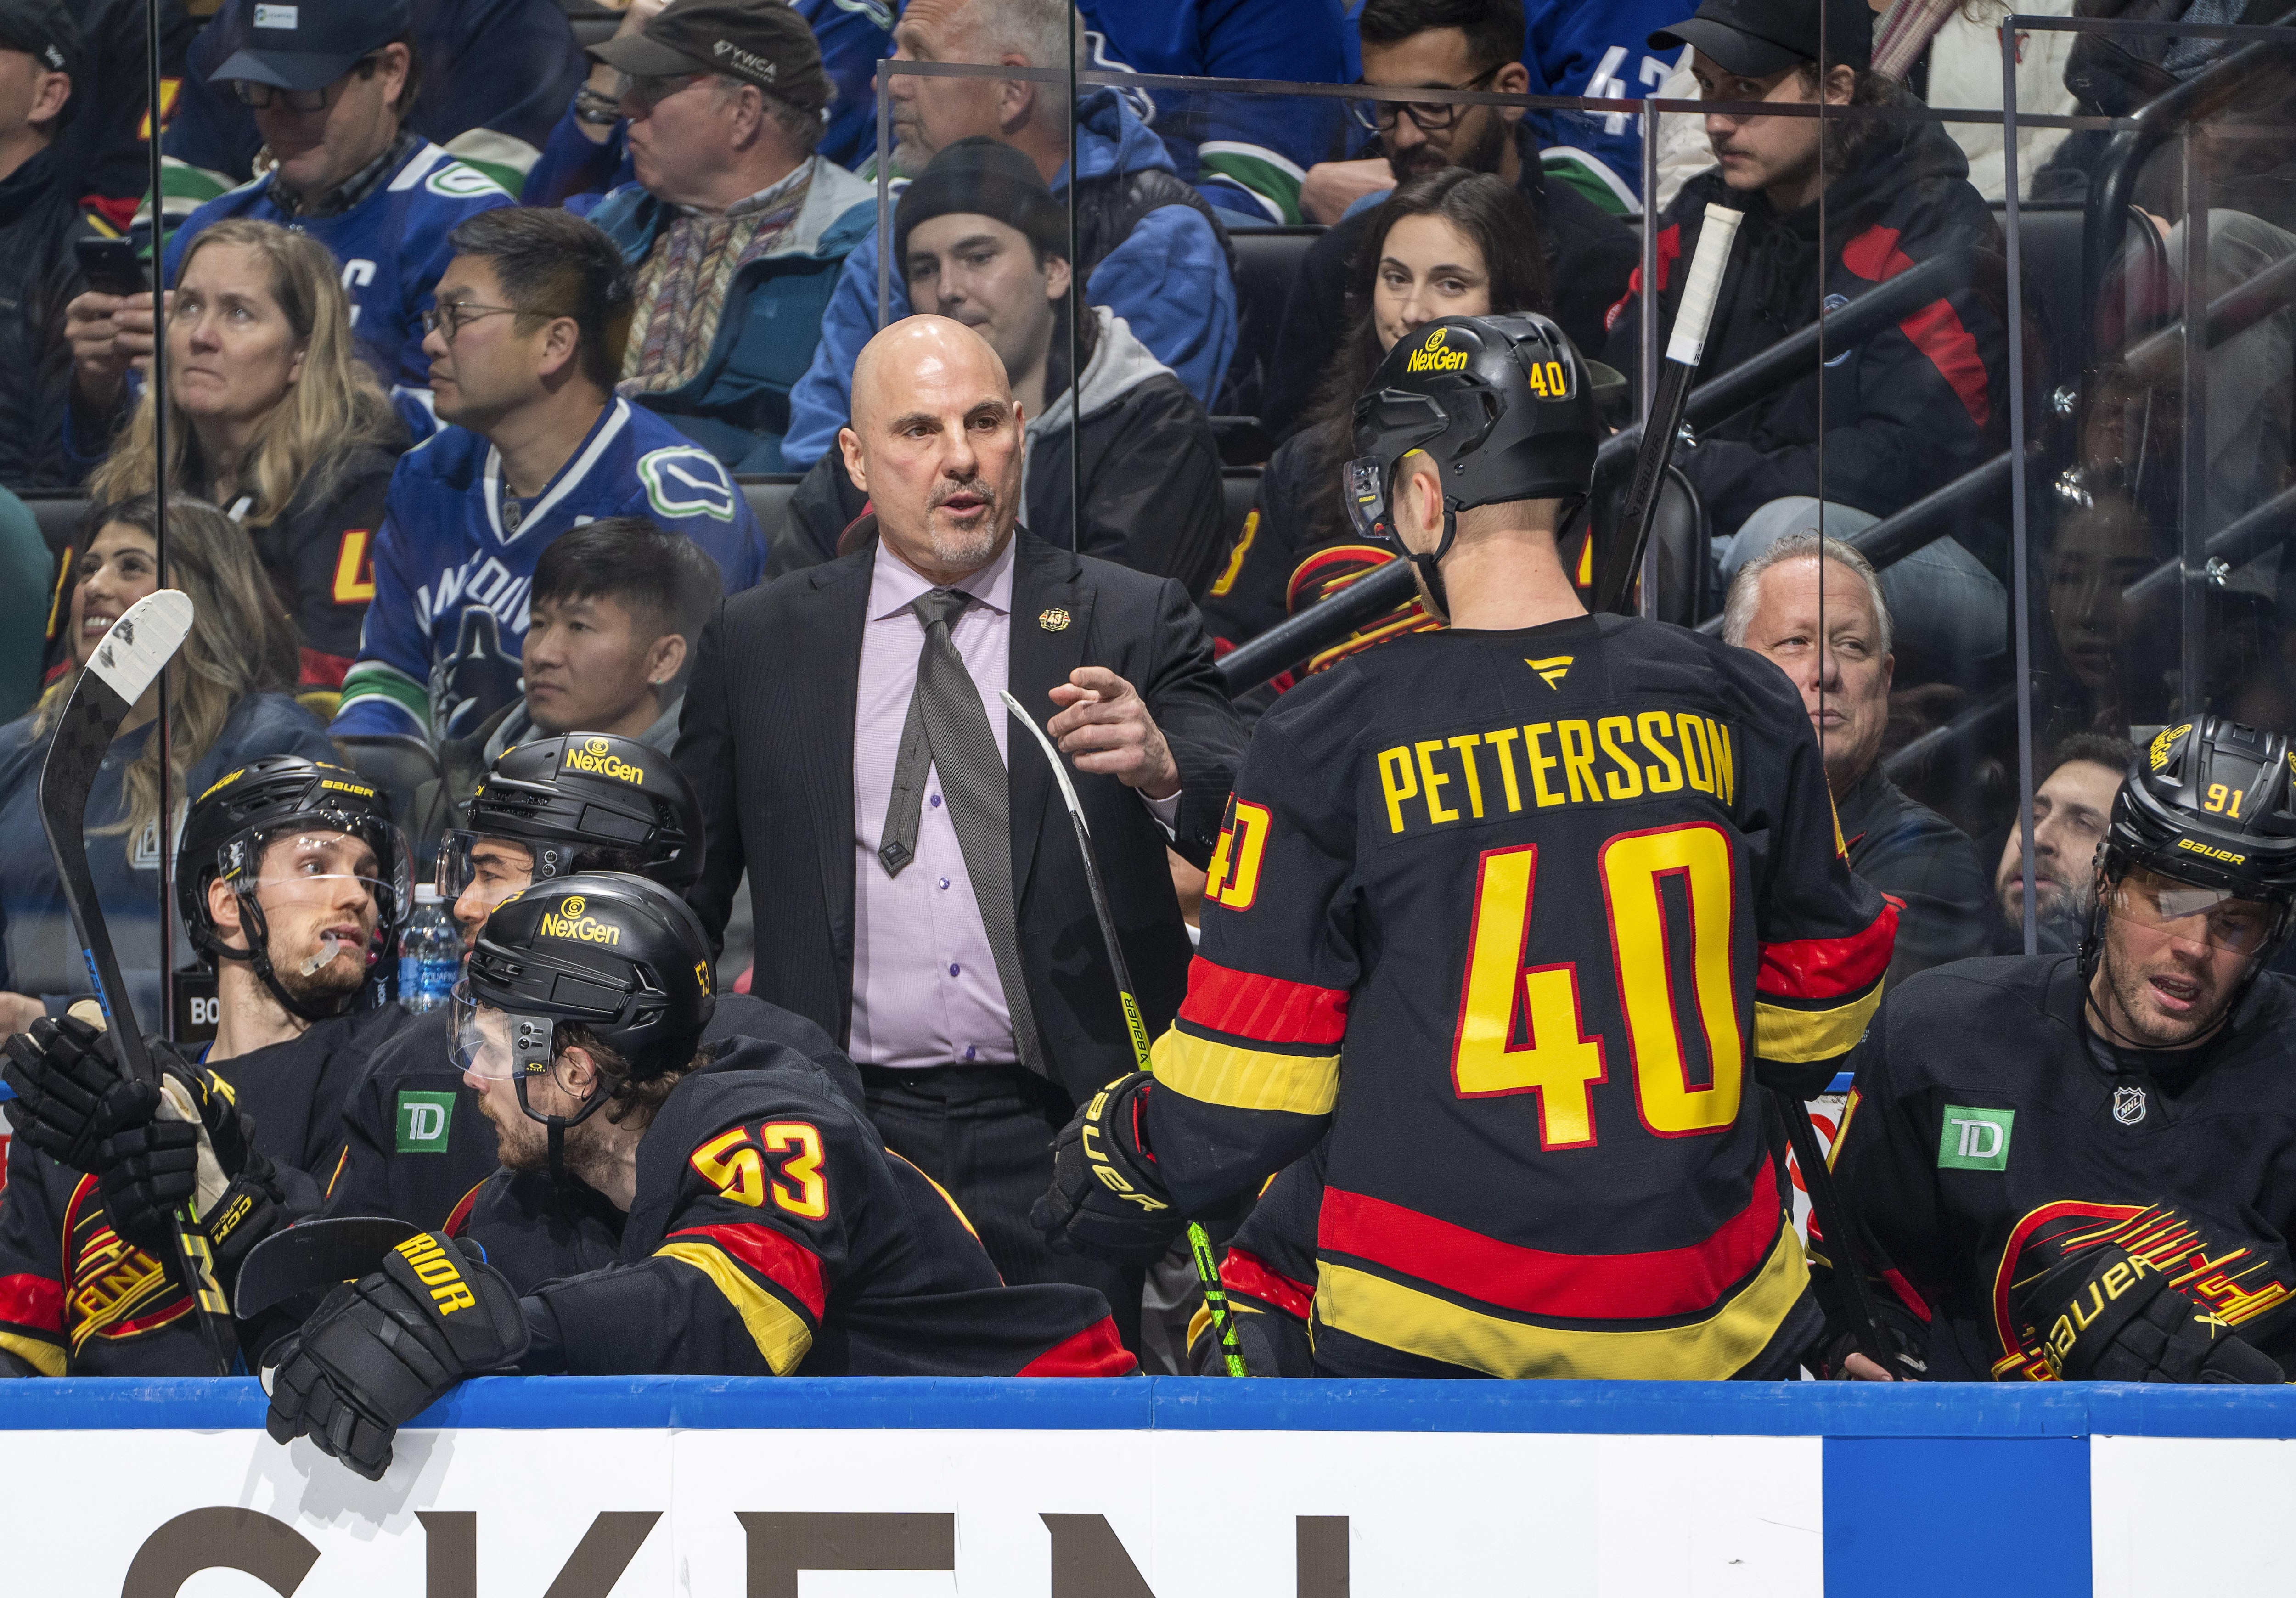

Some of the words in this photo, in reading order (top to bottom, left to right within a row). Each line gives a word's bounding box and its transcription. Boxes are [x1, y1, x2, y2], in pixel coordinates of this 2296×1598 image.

[733, 46, 777, 76] YWCA
[1407, 346, 1468, 372] NexGen
[1530, 362, 1566, 397] 40
[1047, 613, 1062, 625] 43
[565, 748, 643, 785] NexGen
[2150, 728, 2172, 771] NexGen
[321, 779, 374, 798] BAUER
[1377, 710, 1735, 834] PETTERSSON
[2204, 783, 2244, 819] 91
[1204, 791, 1273, 912] 40
[2178, 838, 2245, 866] BAUER
[541, 912, 620, 946] NexGen
[694, 959, 710, 998] 53
[1450, 821, 1745, 1153] 40
[1124, 998, 1147, 1051] BAUER
[404, 1103, 445, 1141] TD
[2121, 1097, 2139, 1116] NHL
[1082, 1072, 1169, 1211] AUER
[1950, 1118, 2003, 1158] TD
[689, 1121, 829, 1221] 53
[214, 1196, 252, 1245] CCM
[392, 1232, 476, 1317] RIOR
